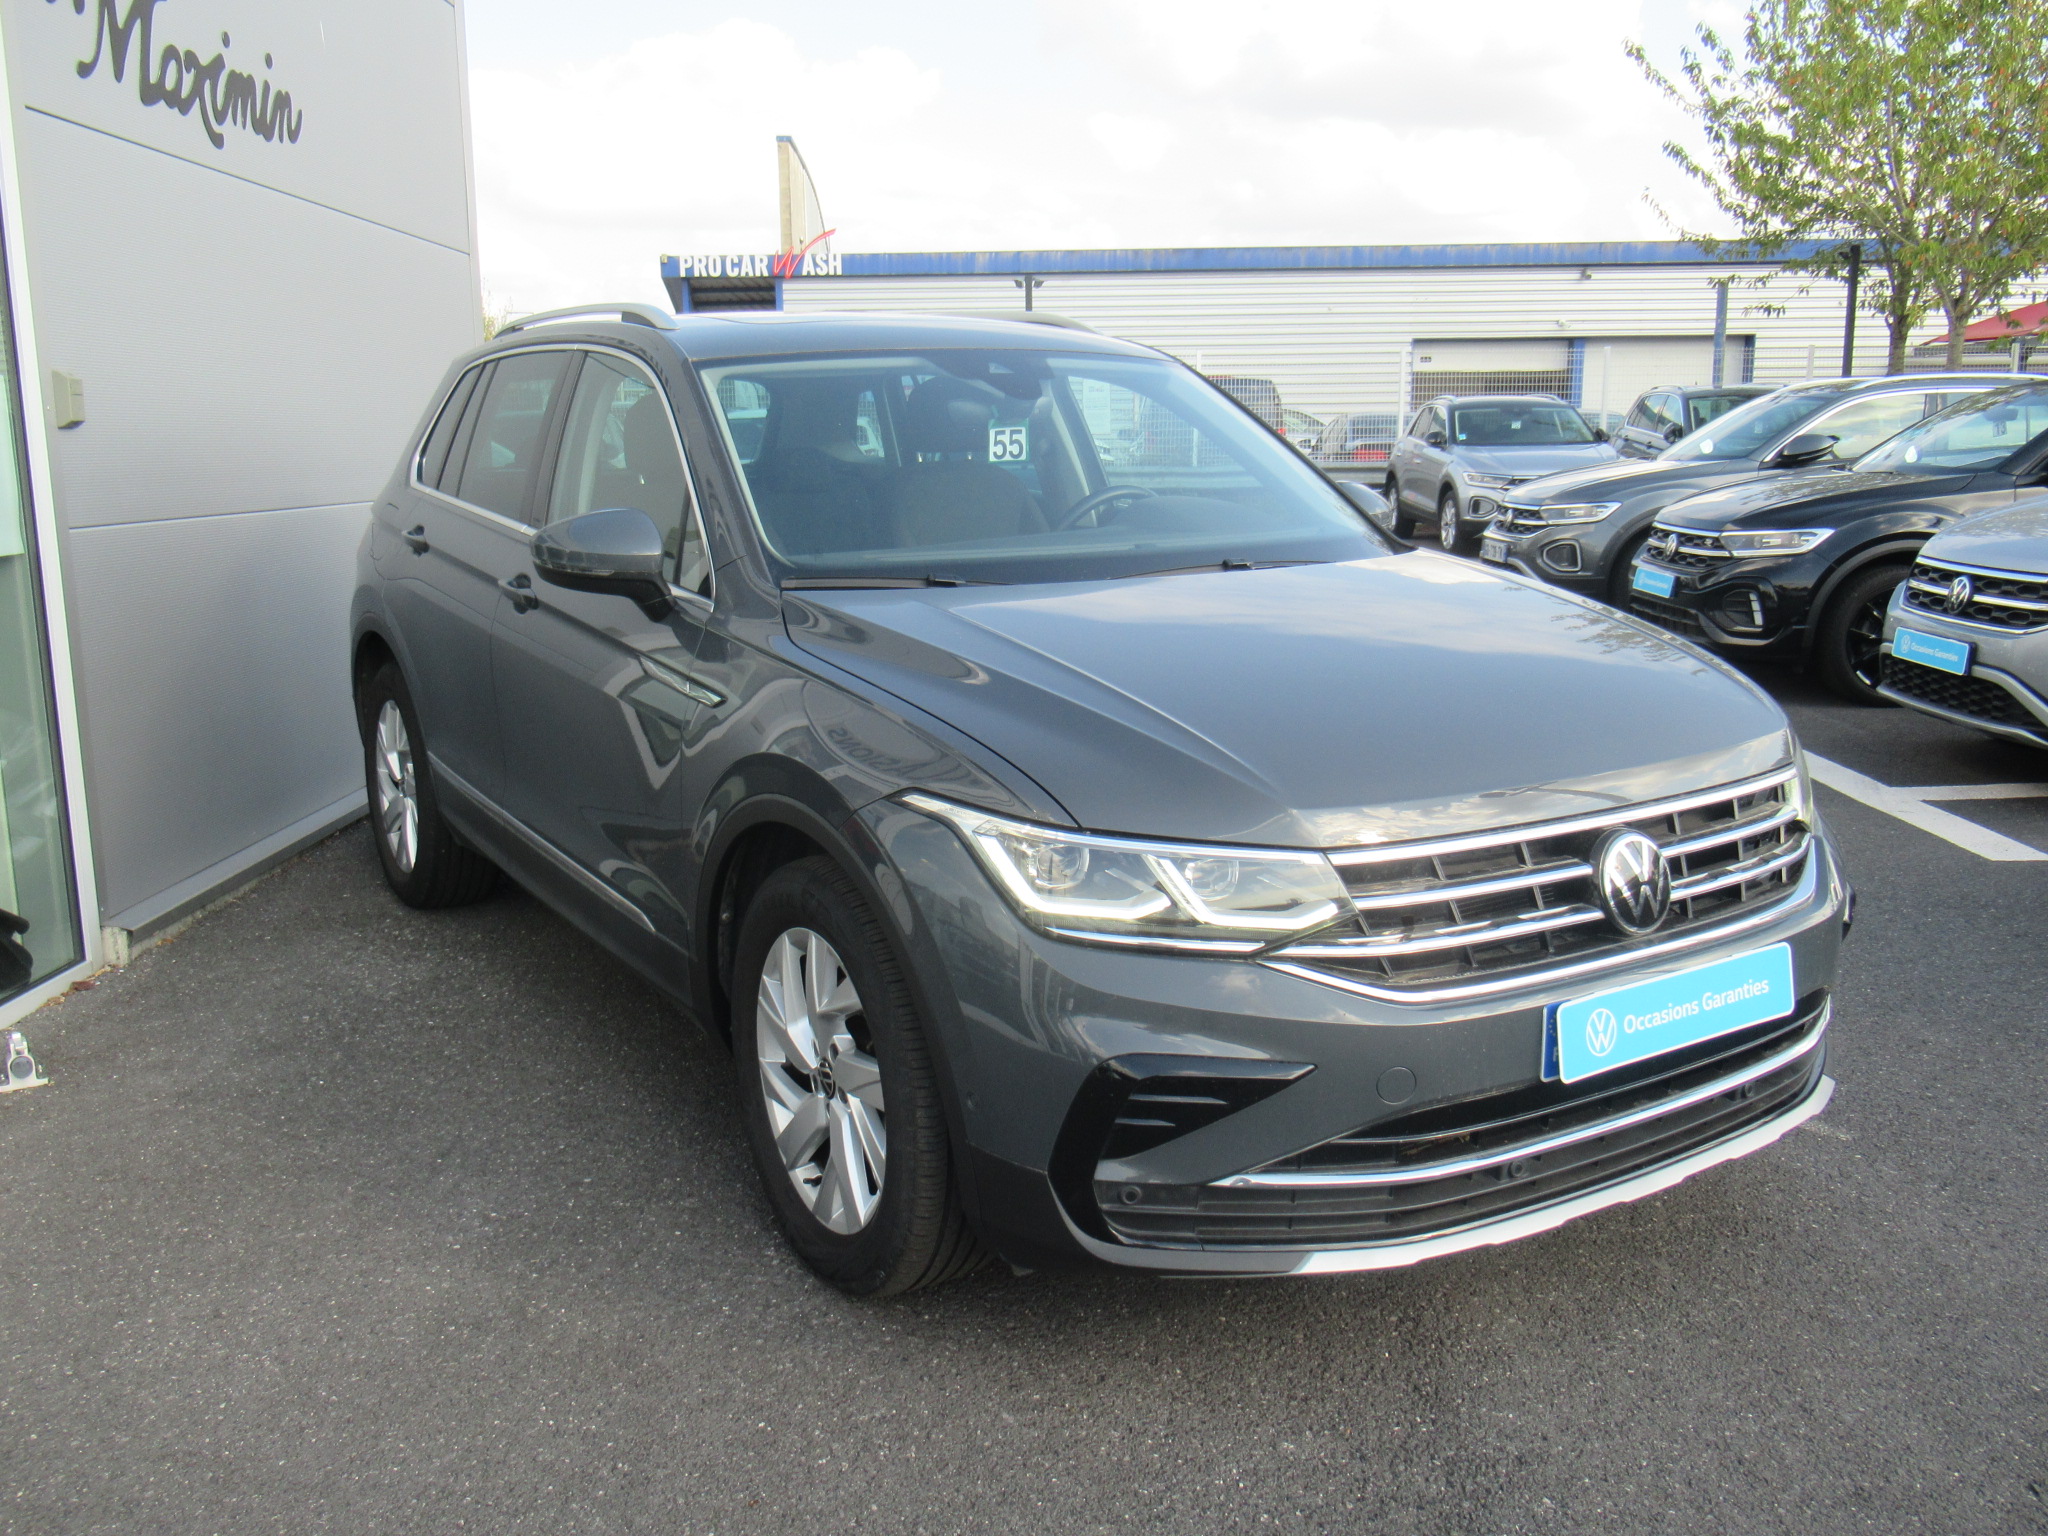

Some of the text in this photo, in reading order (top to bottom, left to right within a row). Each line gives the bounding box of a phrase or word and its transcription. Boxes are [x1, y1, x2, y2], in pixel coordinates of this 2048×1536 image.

[76, 0, 303, 150] Maximin
[679, 228, 843, 280] PRO CAR WASH
[992, 429, 1025, 460] 55
[1624, 1000, 1699, 1034] Occasions
[1702, 979, 1770, 1012] Garanties
